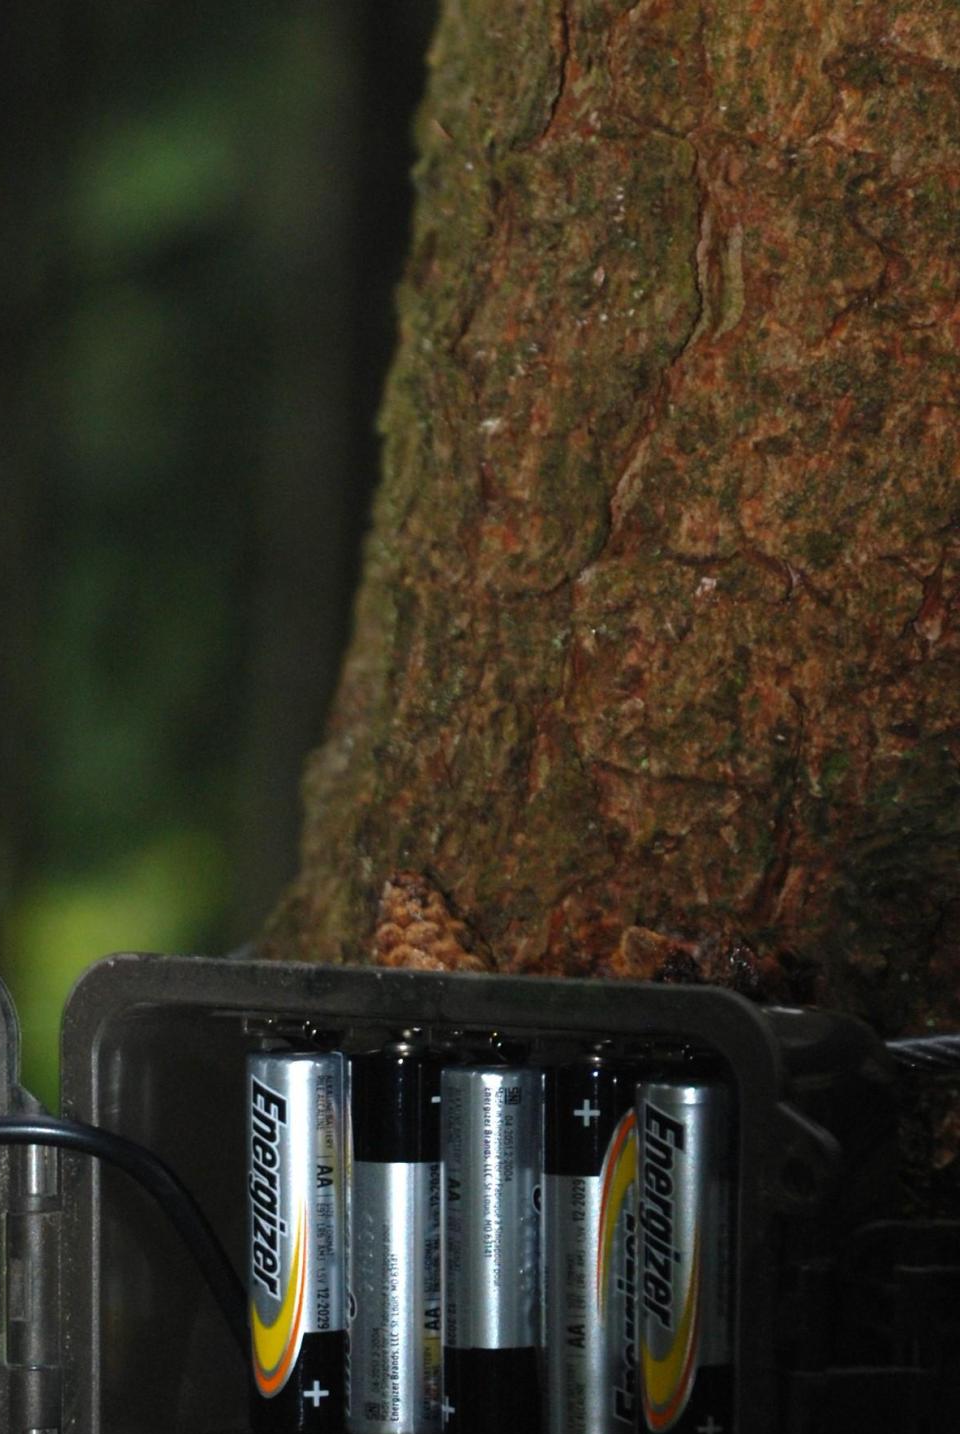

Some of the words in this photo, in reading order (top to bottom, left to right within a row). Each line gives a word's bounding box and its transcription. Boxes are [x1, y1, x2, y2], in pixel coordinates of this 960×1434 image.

[248, 1077, 287, 1299] Energizer
[316, 1165, 334, 1188] AA
[639, 1102, 685, 1331] Energizer
[423, 1307, 441, 1331] AA
[566, 1323, 586, 1349] AA
